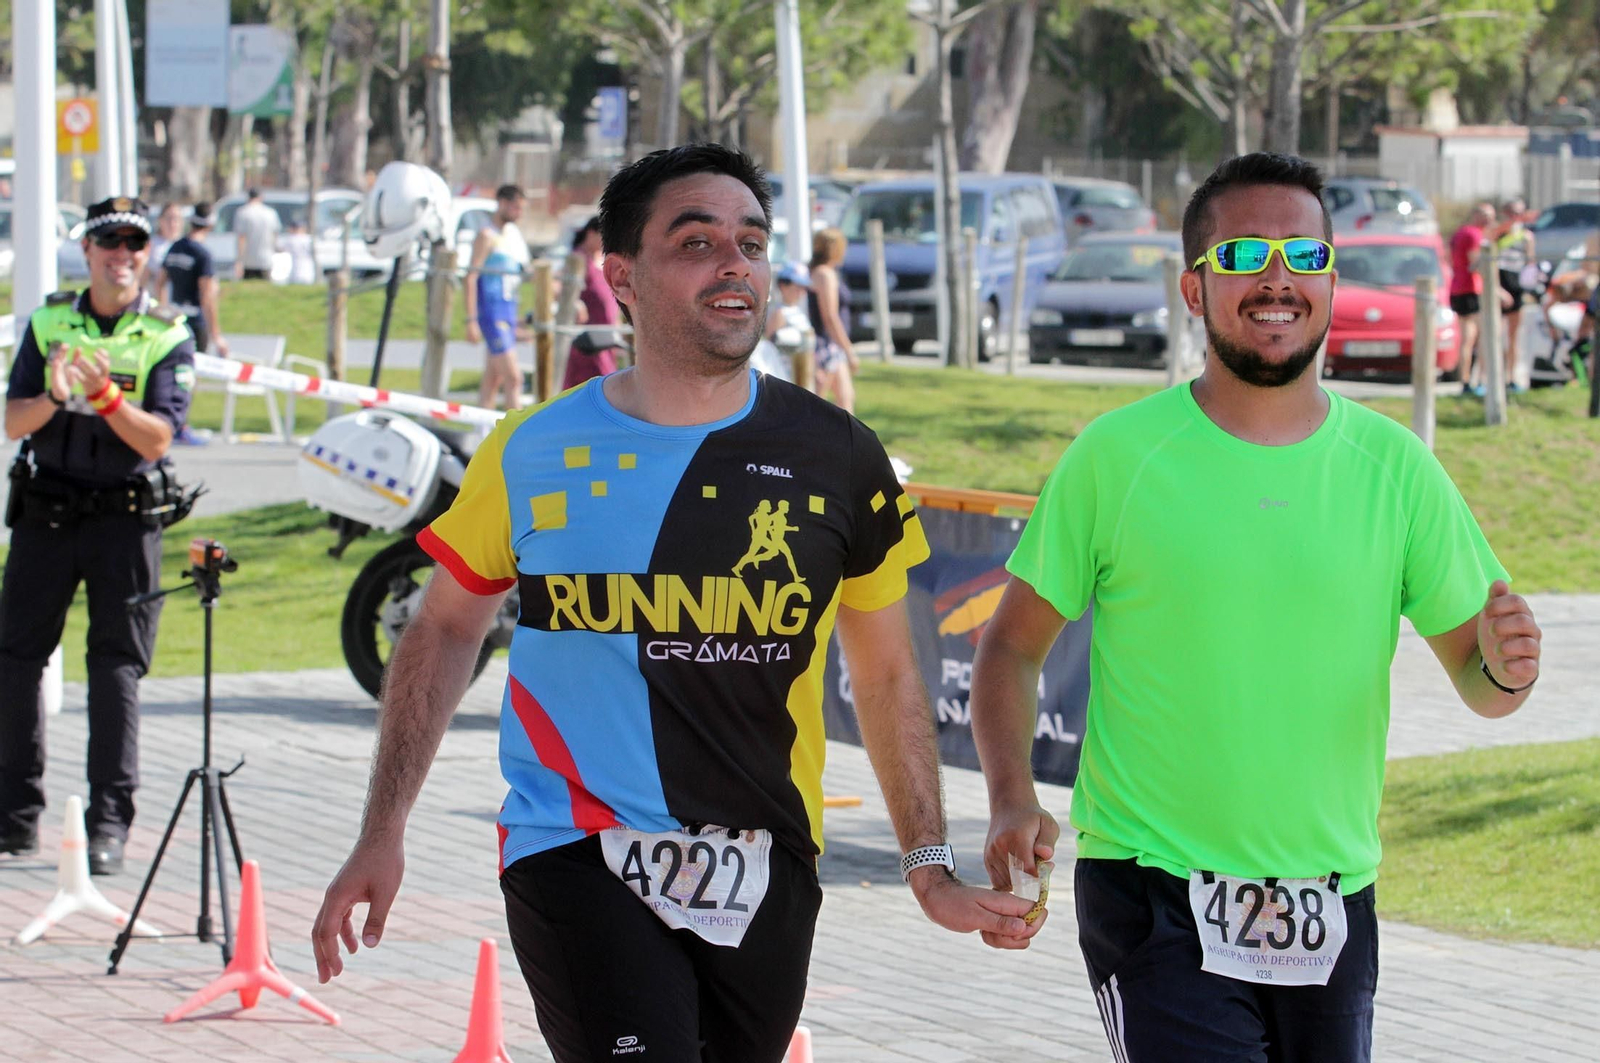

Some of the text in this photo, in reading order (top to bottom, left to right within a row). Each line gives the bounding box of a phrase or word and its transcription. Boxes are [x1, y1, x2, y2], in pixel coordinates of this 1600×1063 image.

[760, 464, 793, 479] SPALL
[545, 573, 812, 637] RUNNING
[646, 635, 791, 664] GRÁMATA
[621, 839, 749, 912] 4222
[693, 915, 750, 929] DEPORTIV
[1204, 880, 1326, 951] 4238
[1207, 944, 1334, 967] AGRUPACIÓN DEPORTIVA
[1255, 970, 1273, 980] 4238
